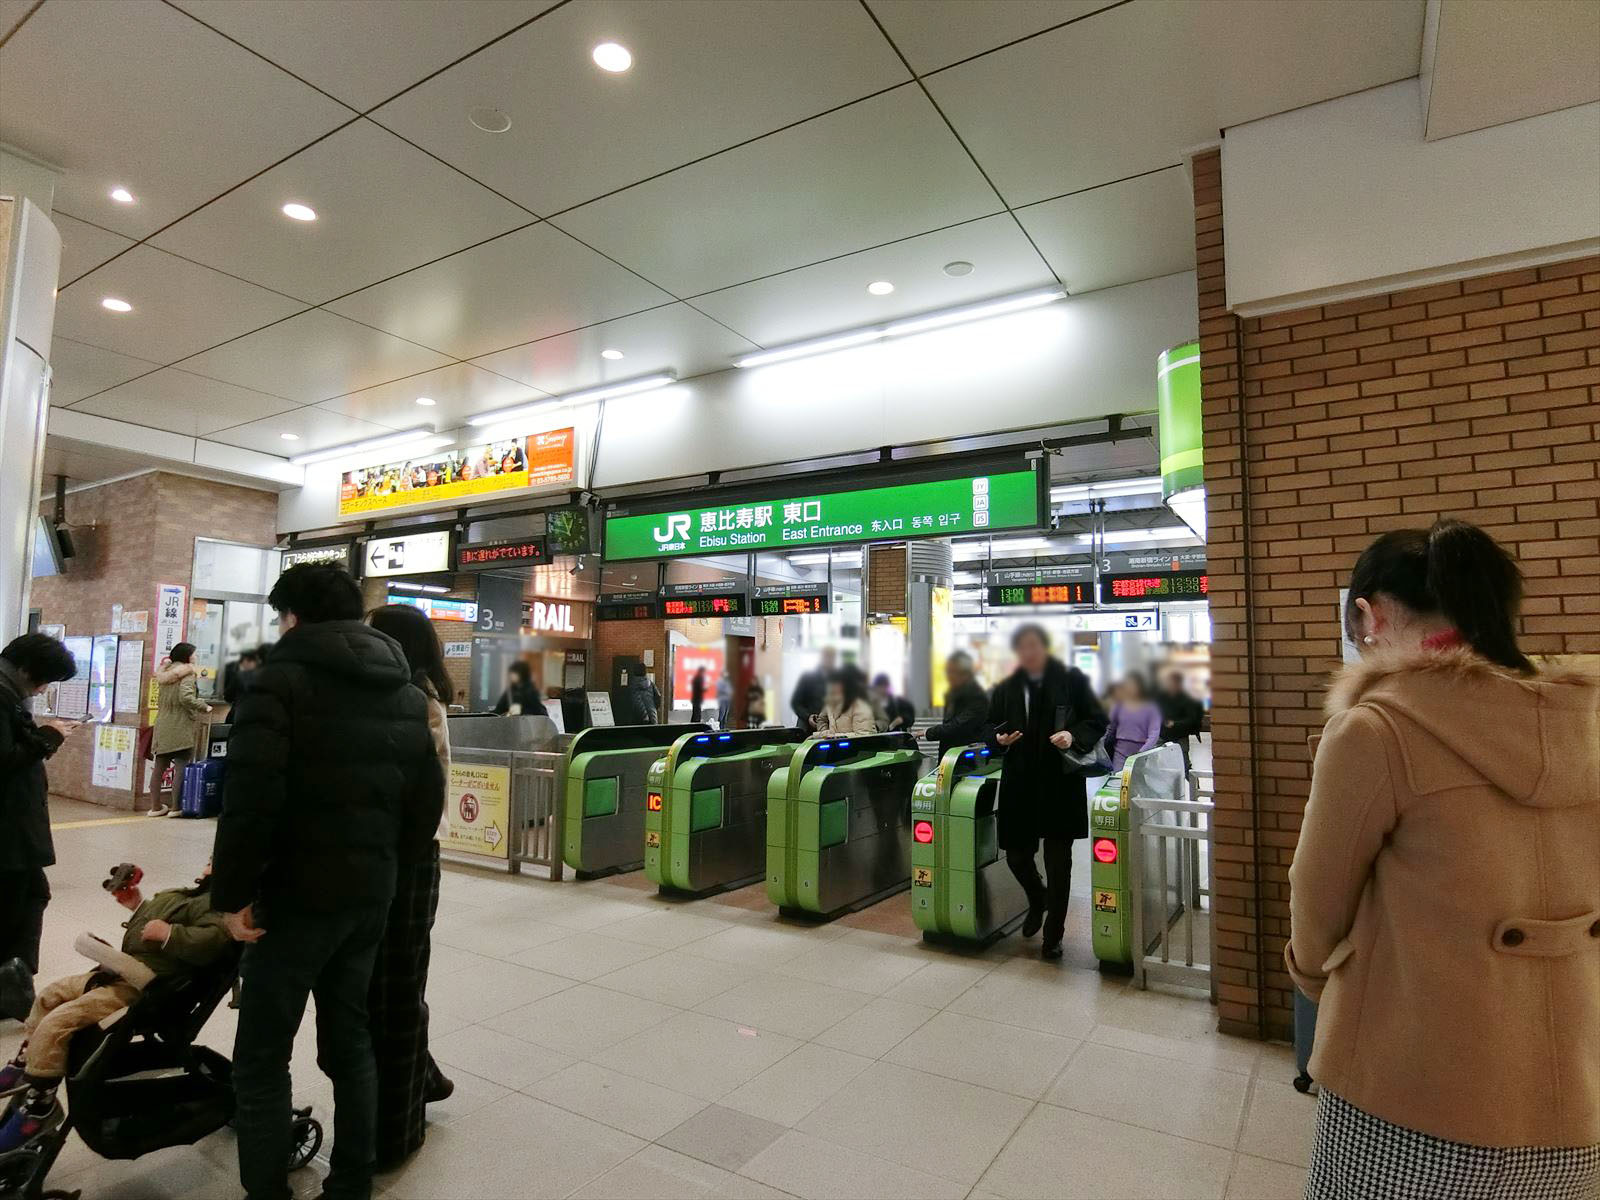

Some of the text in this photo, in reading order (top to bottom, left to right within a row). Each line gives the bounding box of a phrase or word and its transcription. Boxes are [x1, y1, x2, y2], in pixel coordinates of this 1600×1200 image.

[700, 500, 820, 533] 恵比寿駅 東口
[911, 513, 961, 528] 동쪽 입구
[653, 514, 691, 542] JR
[871, 518, 903, 532] 东入口
[700, 522, 863, 548] Ebisu Station East Entrance
[1102, 559, 1111, 572] 3
[994, 572, 1000, 584] 1
[1171, 577, 1199, 586] 12:59
[659, 586, 666, 596] 4
[755, 587, 761, 598] 2
[1171, 585, 1199, 594] 13:29
[165, 596, 180, 607] JR
[165, 608, 178, 618] 線
[468, 606, 475, 619] 3
[533, 601, 575, 633] RAIL
[481, 609, 494, 631] 3
[914, 783, 936, 798] IC
[649, 794, 662, 811] IC
[1094, 796, 1119, 812] IC
